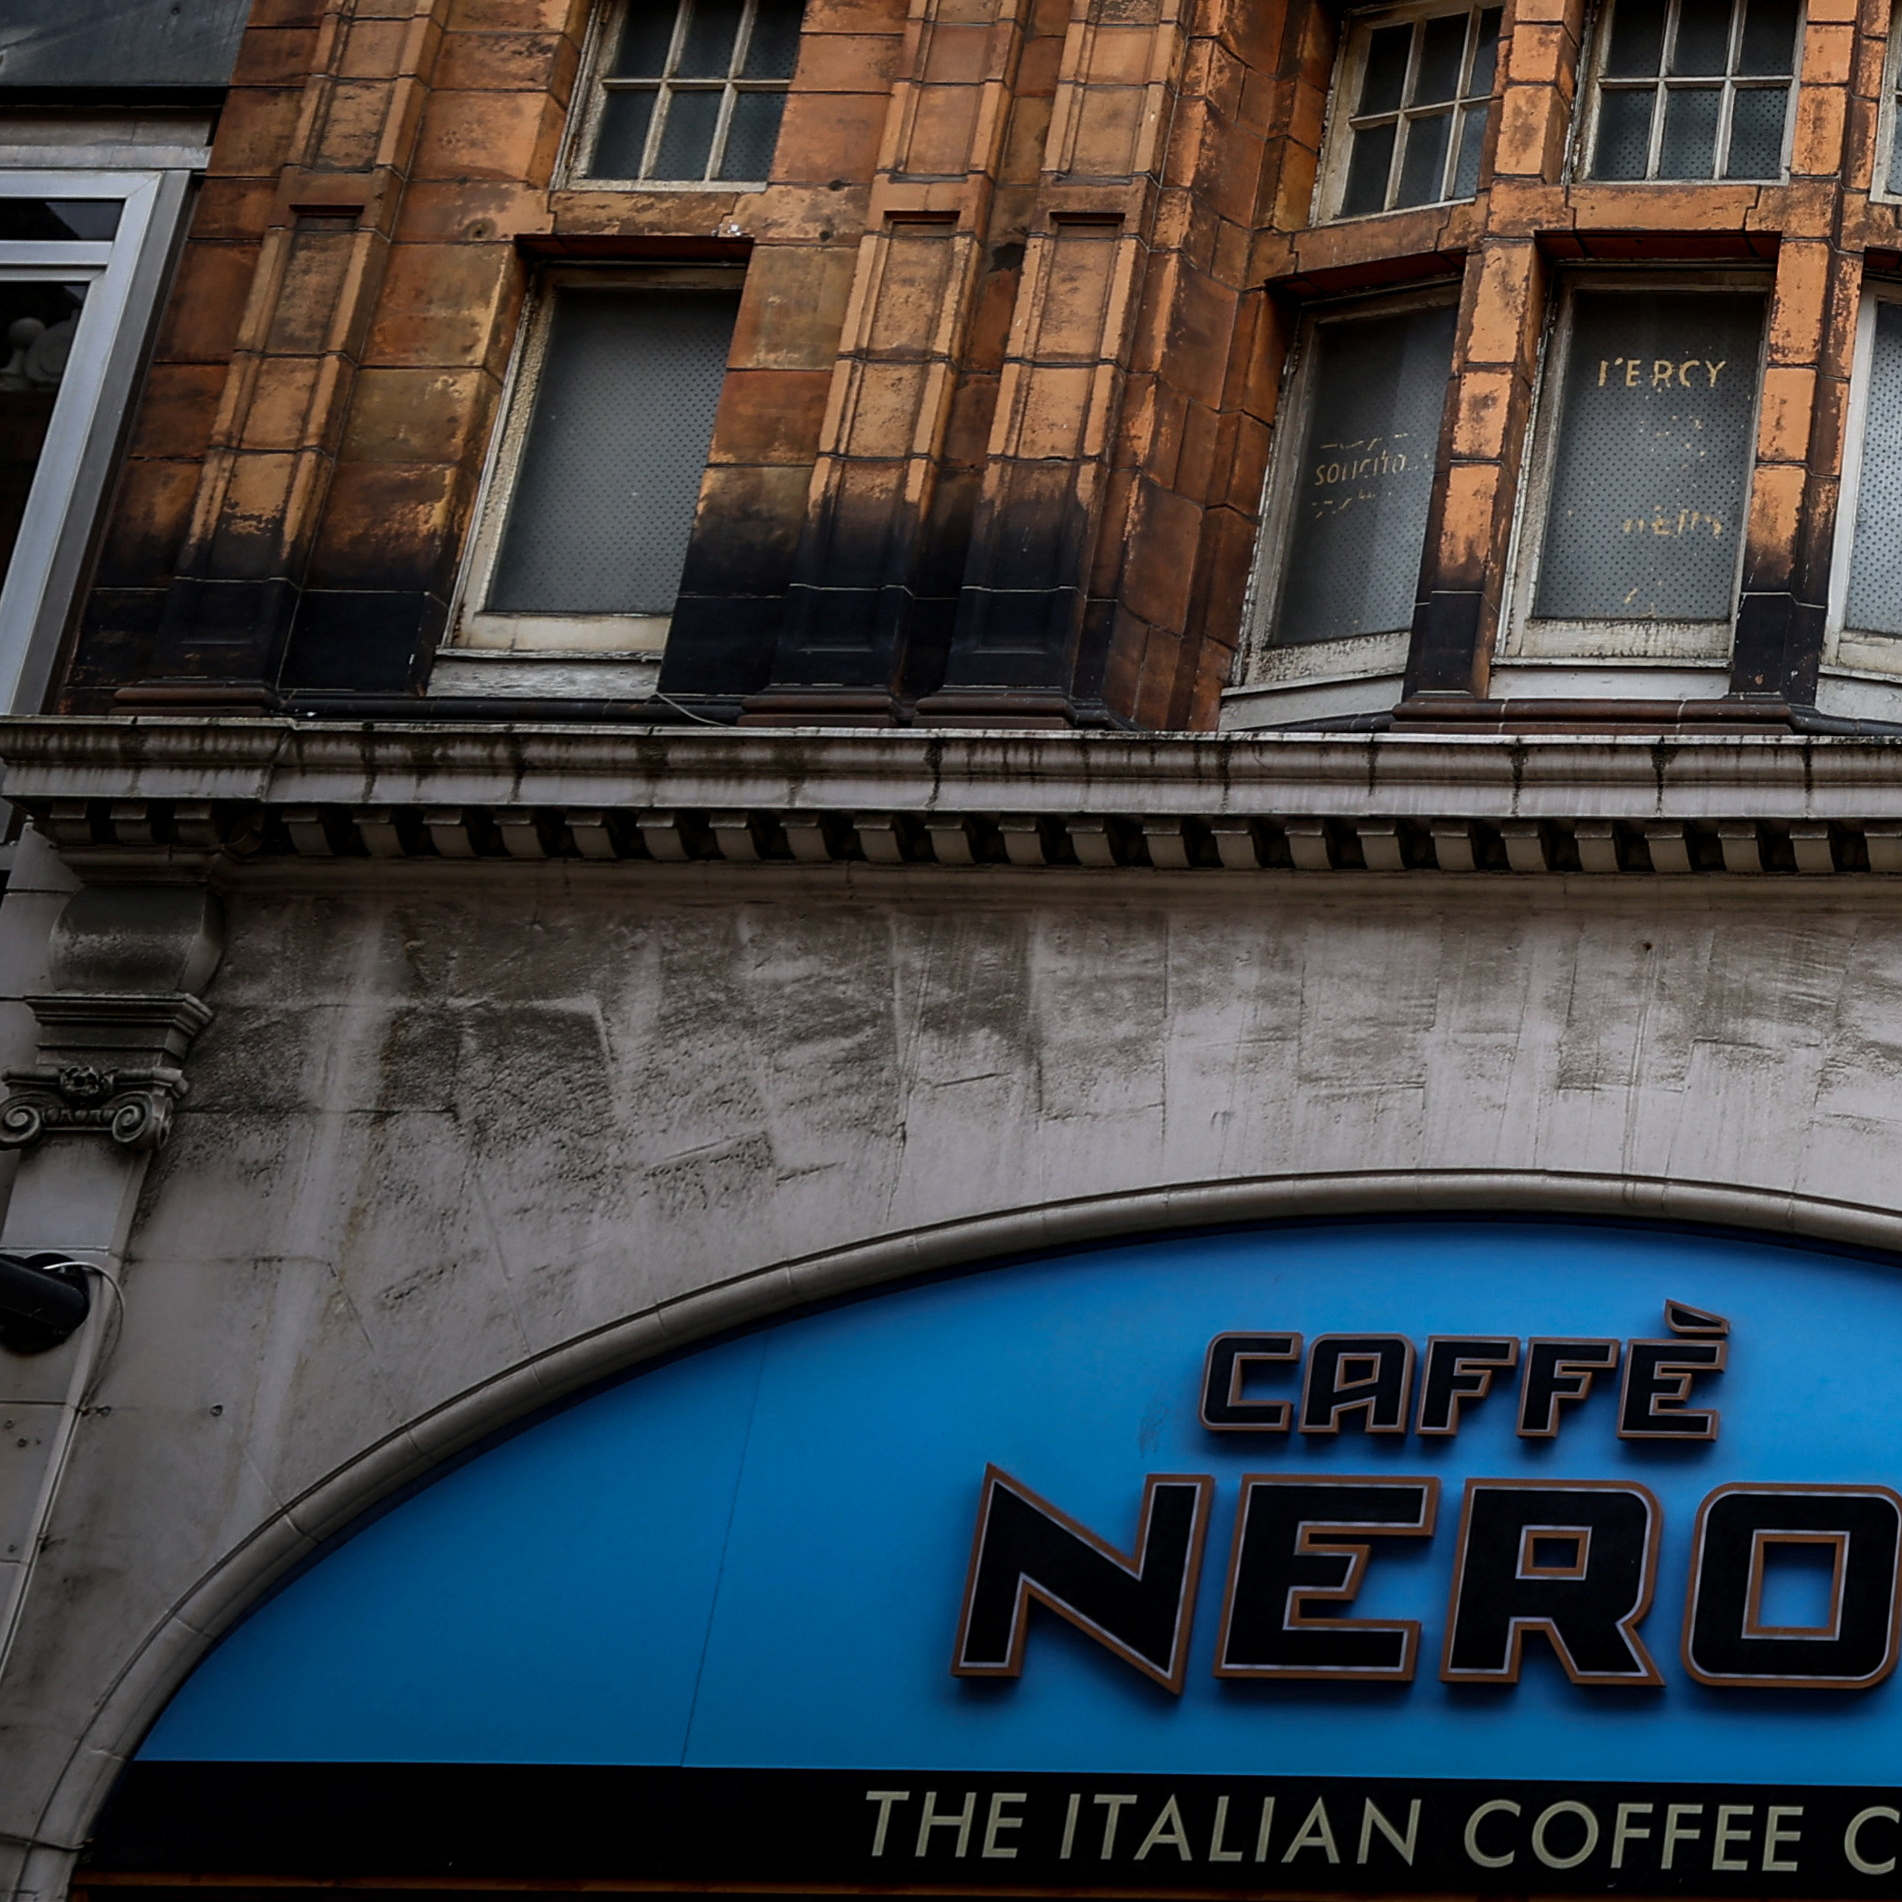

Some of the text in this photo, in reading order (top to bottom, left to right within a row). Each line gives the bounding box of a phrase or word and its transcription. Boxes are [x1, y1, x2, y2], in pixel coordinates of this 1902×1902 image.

[1199, 1298, 1730, 1439] CAFFÈ
[865, 1791, 1028, 1858] THE
[1060, 1793, 1421, 1866] ITALIAN
[1463, 1799, 1804, 1872] COFFEE
